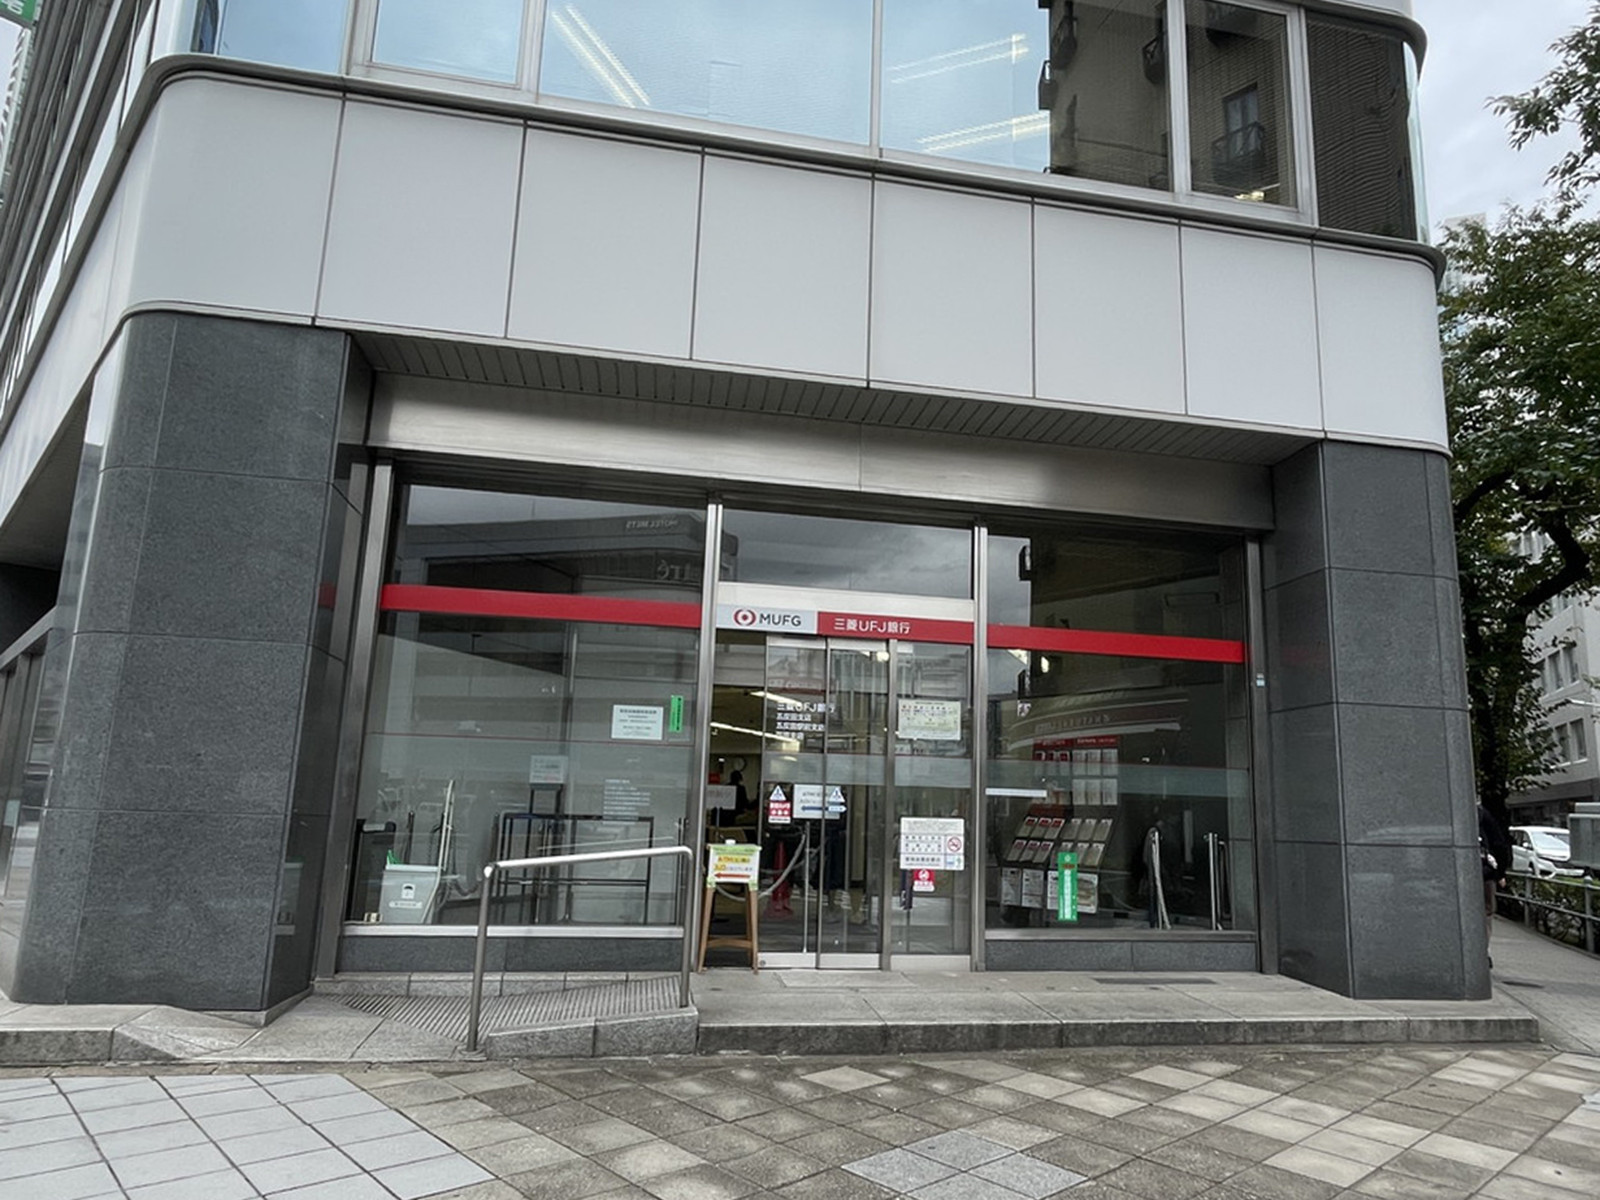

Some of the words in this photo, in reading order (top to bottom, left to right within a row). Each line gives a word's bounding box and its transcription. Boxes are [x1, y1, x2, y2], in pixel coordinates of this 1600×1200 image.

[759, 613, 802, 627] MUFG
[833, 617, 911, 635] 三菱UFJ銀行
